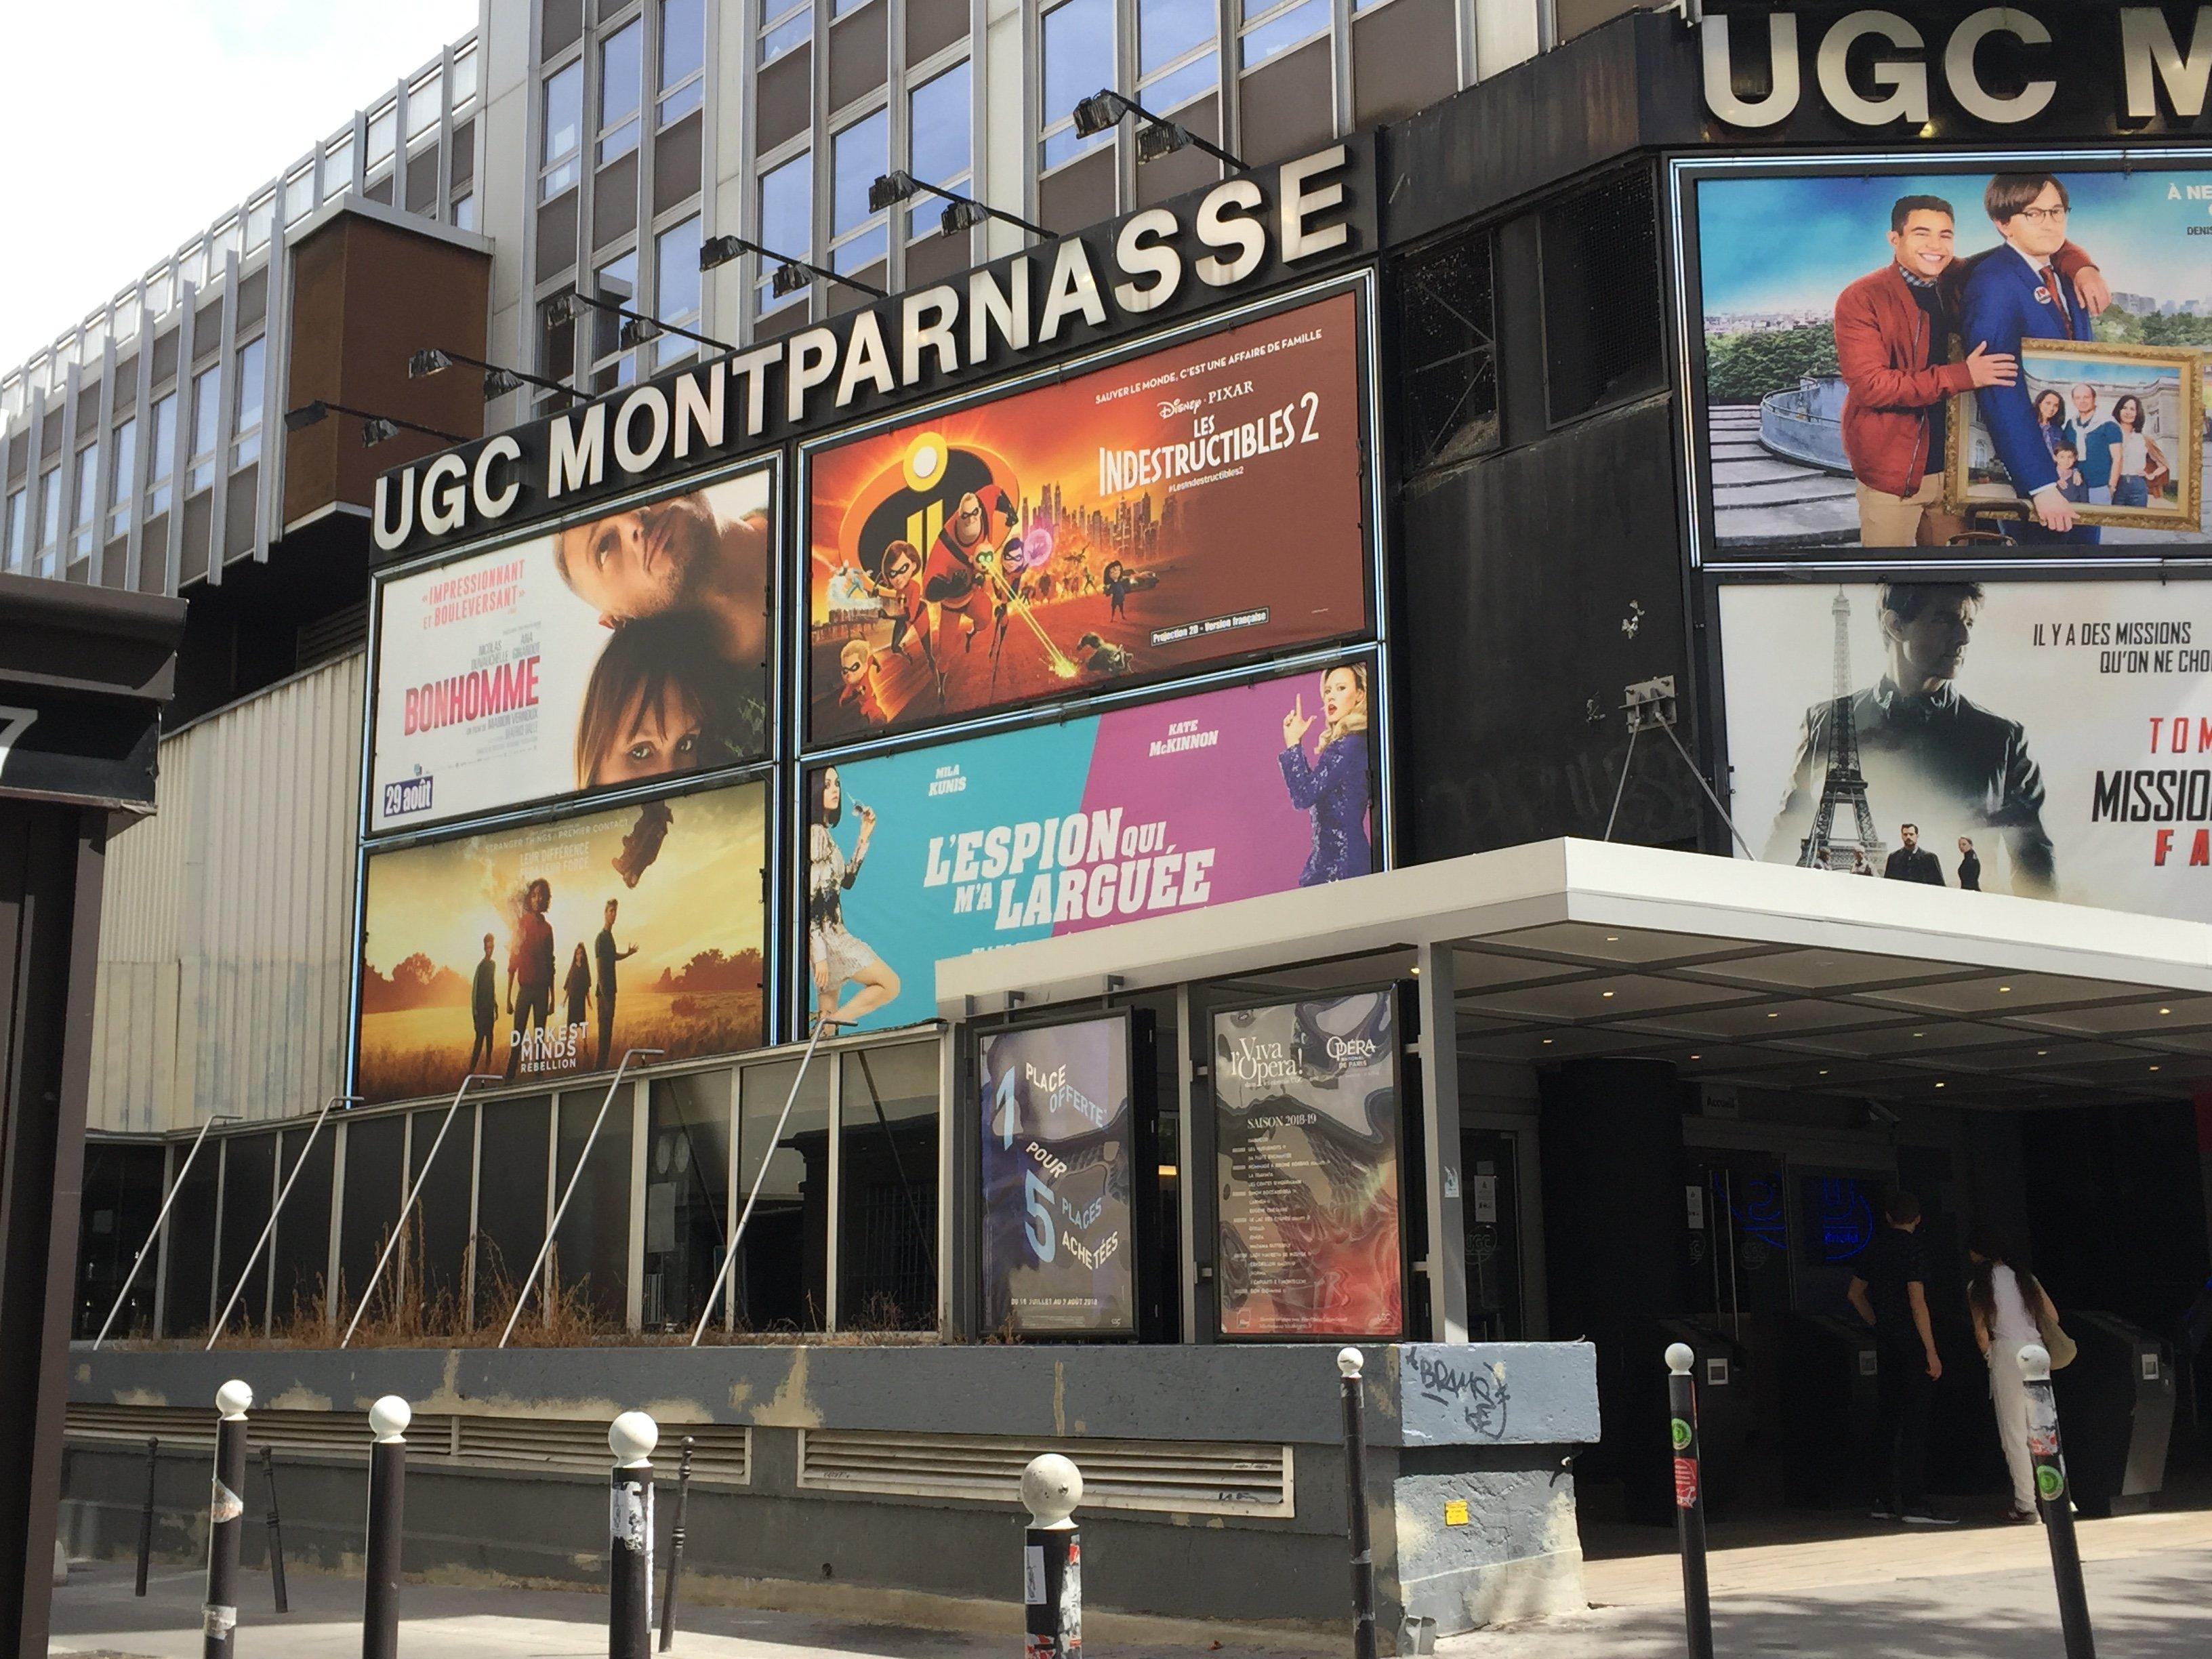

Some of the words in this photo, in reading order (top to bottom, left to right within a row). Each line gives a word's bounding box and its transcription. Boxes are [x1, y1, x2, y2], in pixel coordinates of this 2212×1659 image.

[1701, 6, 2057, 127] UGC
[2168, 182, 2182, 200] À
[373, 436, 521, 551] UGC
[548, 143, 1347, 499] MONTPARNASSE
[1095, 386, 1129, 405] SAUVER
[1130, 382, 1142, 394] LE
[1143, 373, 1179, 390] MONDE,
[1180, 365, 1205, 380] C'EST
[1207, 357, 1226, 373] UNE
[1228, 346, 1266, 366] AFFAIRE
[1267, 340, 1280, 353] DE
[1282, 329, 1322, 349] FAMILLE
[1208, 380, 1254, 405] PIXAR
[1193, 415, 1215, 439] LES
[1099, 403, 1295, 497] INDESTRUCTIBLES
[1300, 391, 1319, 444] 2
[1153, 628, 1187, 644] Projection
[1204, 619, 1231, 632] Version
[1232, 611, 1266, 626] française
[2034, 623, 2045, 646] IL
[2053, 623, 2062, 646] Y
[2066, 623, 2076, 646] A
[2082, 622, 2111, 646] DES
[2116, 621, 2192, 645] MISSIONS
[2100, 651, 2149, 674] QU'ON
[2154, 650, 2173, 673] NE
[2178, 649, 2212, 673] CHO
[405, 655, 540, 736] BONHOMME
[1168, 720, 1199, 736] KATE
[1149, 730, 1218, 757] McKINNON
[928, 776, 966, 796] KUNIS
[935, 764, 960, 779] MILA
[386, 783, 401, 815] 29
[403, 779, 432, 811] août
[2092, 769, 2212, 823] MISSIO
[923, 807, 1123, 888] L'ESPION
[1120, 821, 1167, 858] QUI
[954, 882, 993, 914] M'A
[995, 844, 1216, 930] LARGUÉE
[510, 1021, 589, 1047] DARKEST
[1326, 1036, 1376, 1061] OPÉRA
[521, 1040, 576, 1062] MINDS
[1239, 1037, 1284, 1061] Viva
[520, 1058, 576, 1073] REBELLION
[1025, 1063, 1067, 1092] PLACE
[996, 1065, 1015, 1151] 1
[1247, 1115, 1284, 1130] SAISON
[1025, 1141, 1067, 1179] POUR
[1025, 1168, 1056, 1263] 5
[1062, 1197, 1103, 1229] PLACES
[1062, 1231, 1118, 1271] ACHETÉES
